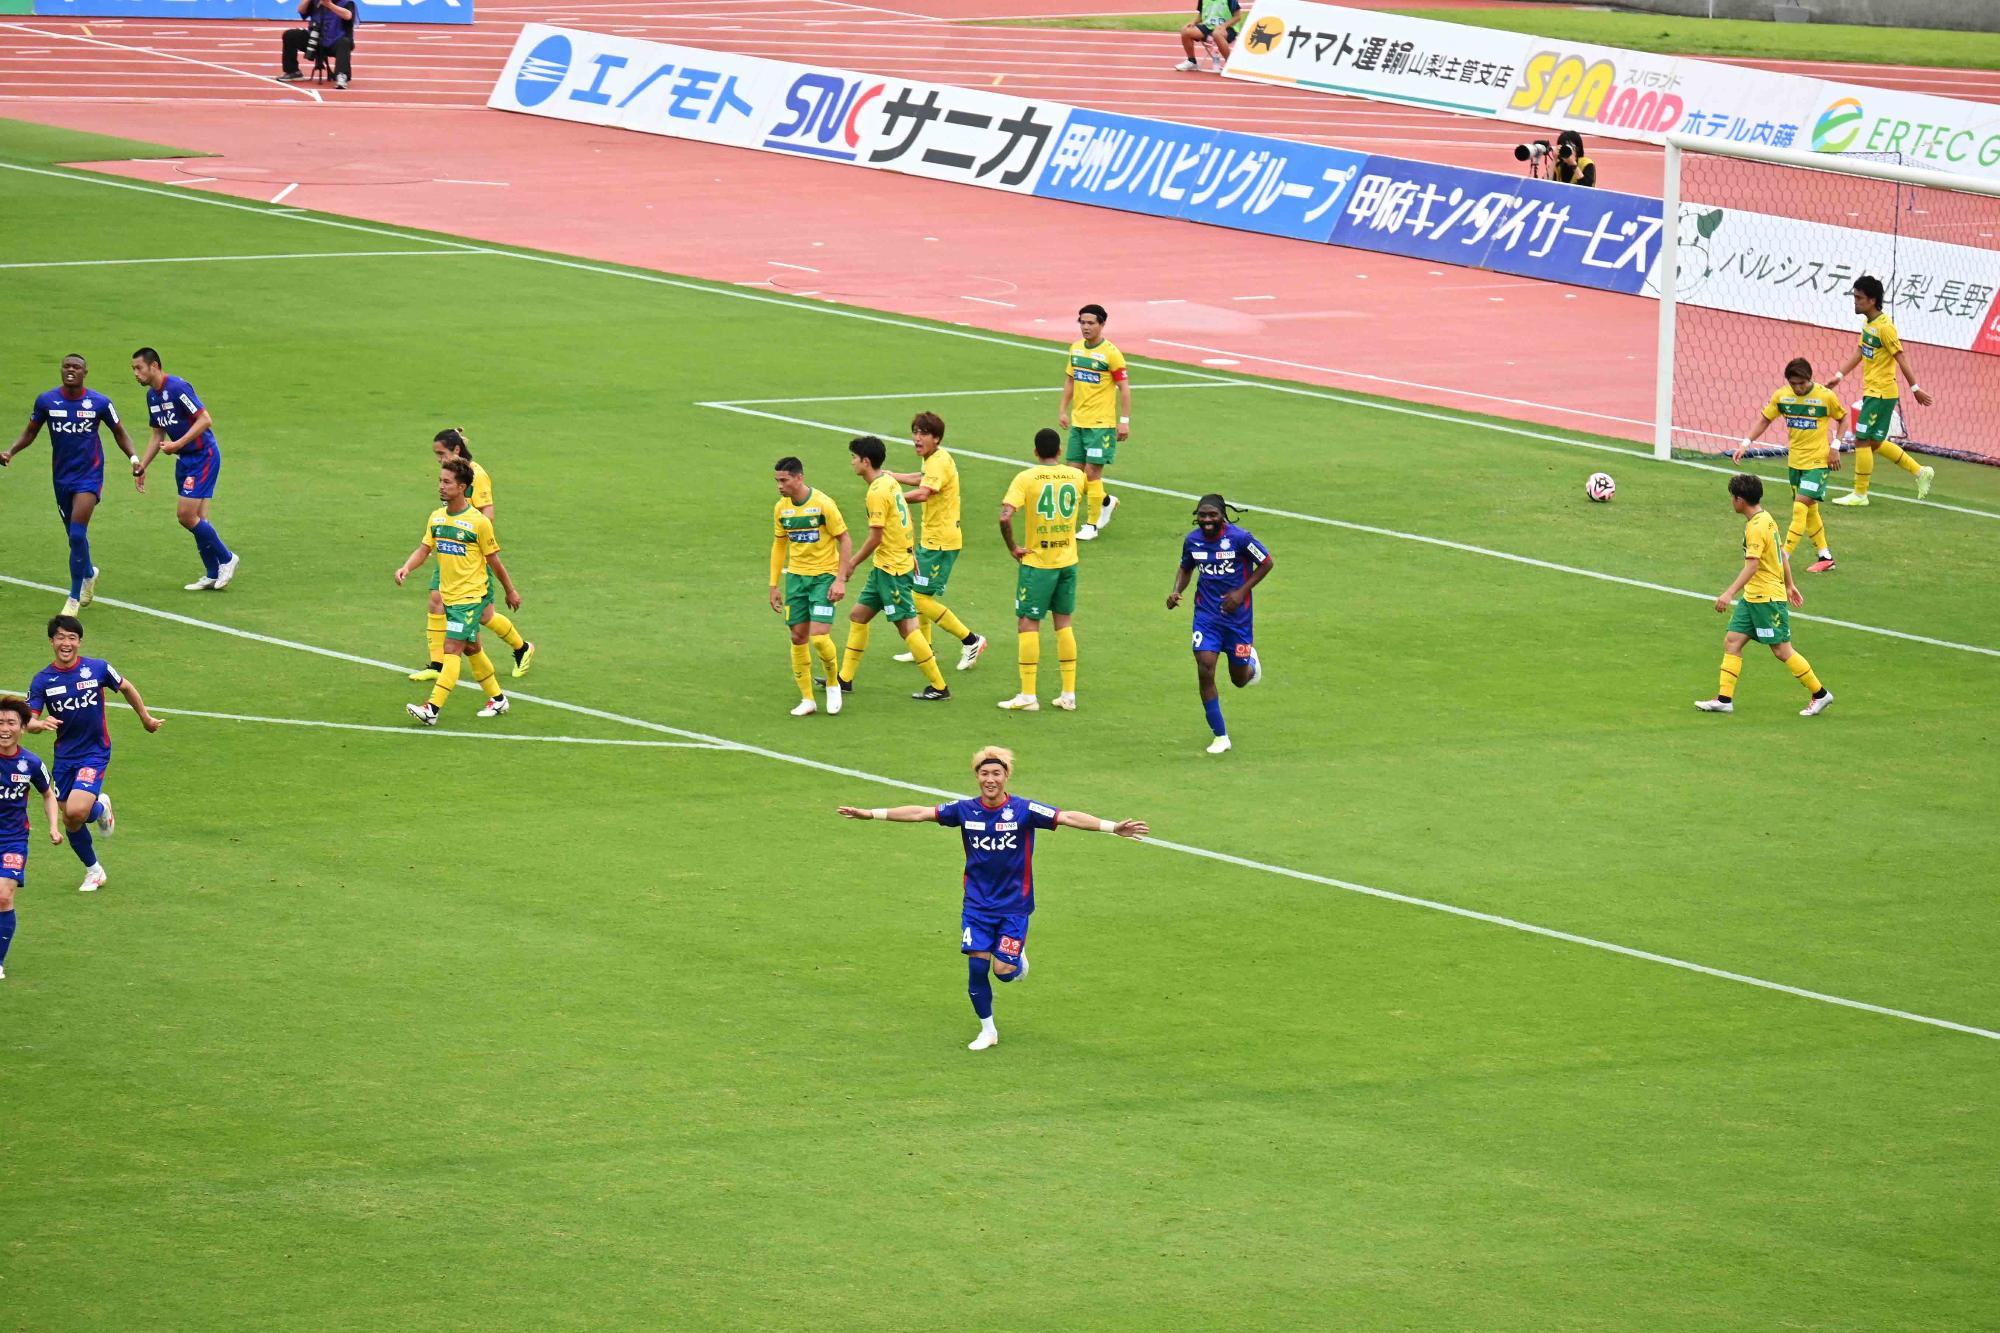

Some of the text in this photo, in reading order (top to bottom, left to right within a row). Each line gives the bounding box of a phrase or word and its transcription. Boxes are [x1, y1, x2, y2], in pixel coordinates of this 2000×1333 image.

[568, 53, 753, 124] エノモト
[868, 87, 1053, 186] サニカ
[1680, 109, 1799, 149] ホテル内藤
[1865, 117, 1974, 167] ERTEC
[1050, 122, 1358, 224] 甲州リハビリグループ
[1346, 173, 1663, 273] 甲府キンダイサービス
[52, 419, 93, 433] はくばく
[1037, 482, 1077, 520] 40
[1193, 630, 1203, 648] 9
[52, 690, 98, 712] はくばく
[969, 831, 1018, 851] はくばく
